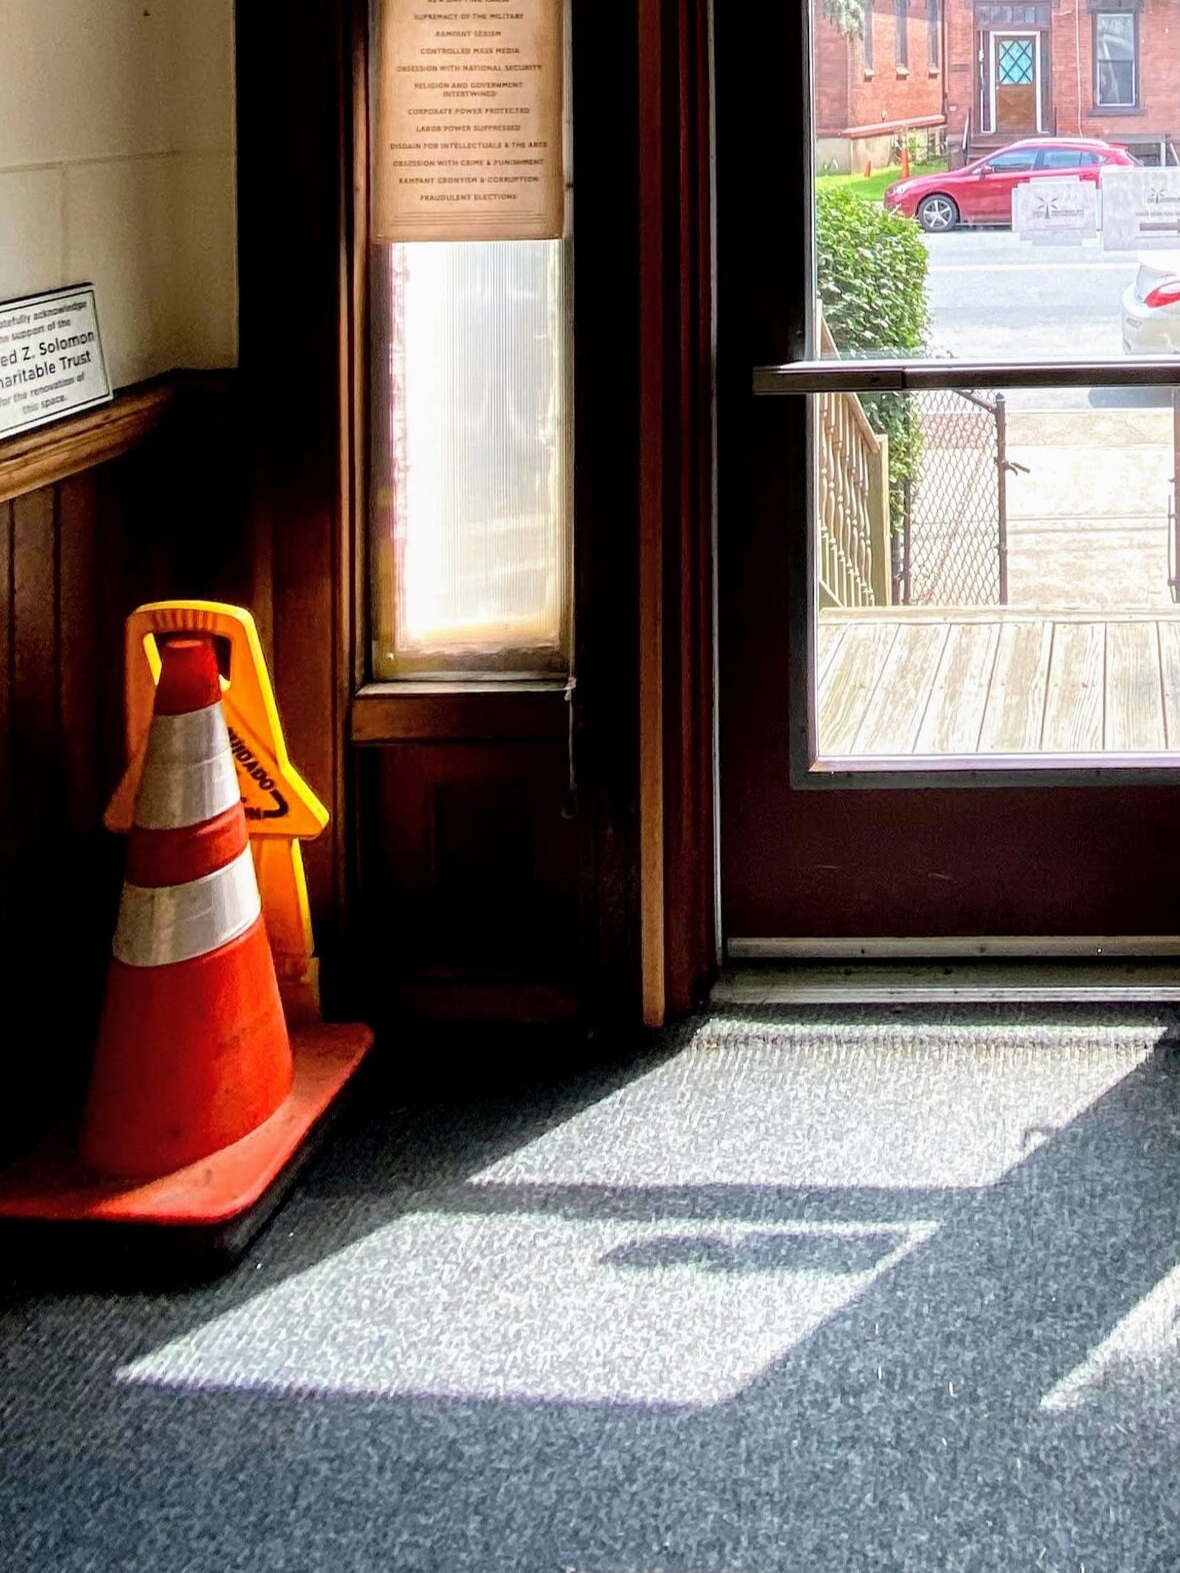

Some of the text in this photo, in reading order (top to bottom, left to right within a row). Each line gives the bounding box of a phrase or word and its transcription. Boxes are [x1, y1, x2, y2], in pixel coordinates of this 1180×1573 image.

[442, 90, 497, 98] INTERTWINED
[21, 346, 36, 361] Z.
[39, 331, 95, 356] Solomon
[59, 351, 92, 371] Trust
[227, 726, 275, 791] UIDADO
